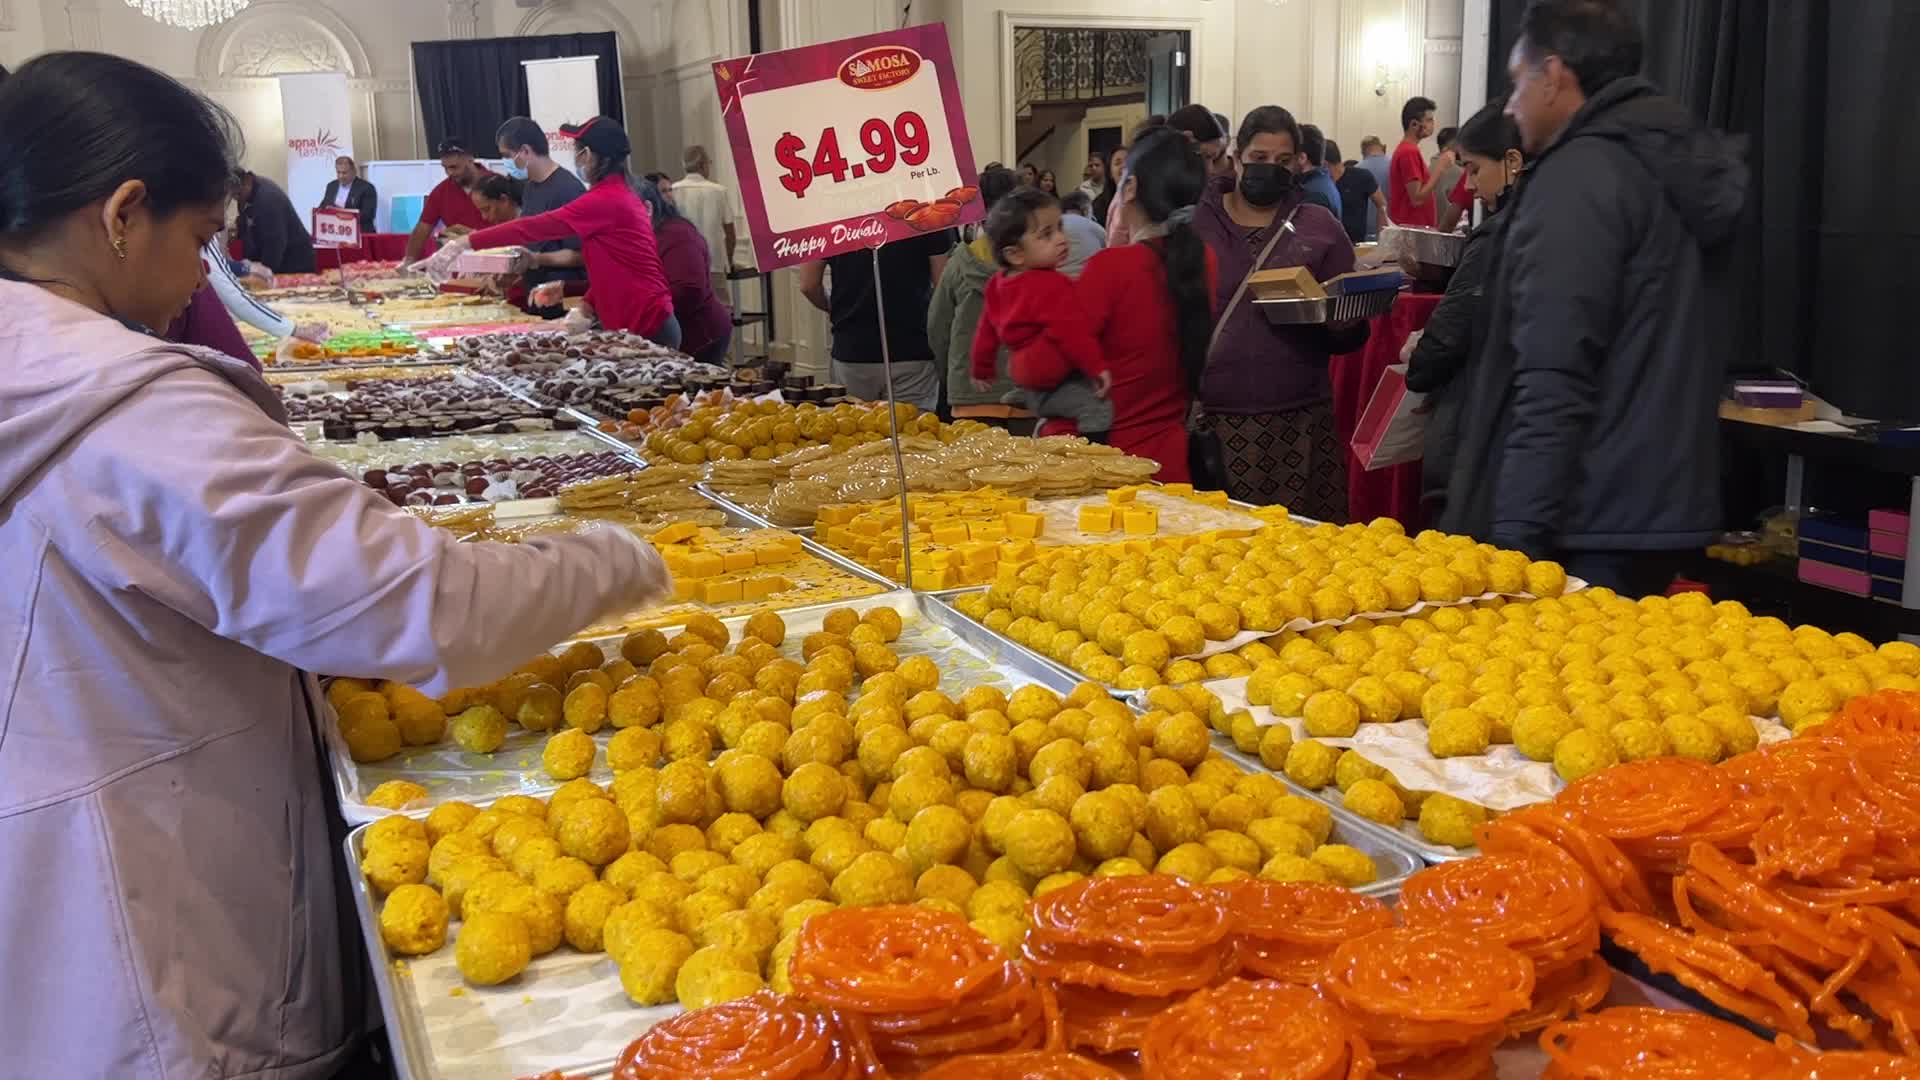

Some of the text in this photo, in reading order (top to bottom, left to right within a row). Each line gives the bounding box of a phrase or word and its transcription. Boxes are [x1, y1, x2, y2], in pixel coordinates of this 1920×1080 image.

[848, 53, 910, 76] SAMOSA
[853, 74, 878, 85] SWEET
[878, 68, 910, 80] FACTORY
[288, 139, 317, 151] apna
[774, 111, 930, 199] $4.99
[910, 168, 941, 180] Per Lb.
[320, 222, 353, 236] $5.99
[773, 222, 885, 258] Happy Diwali
